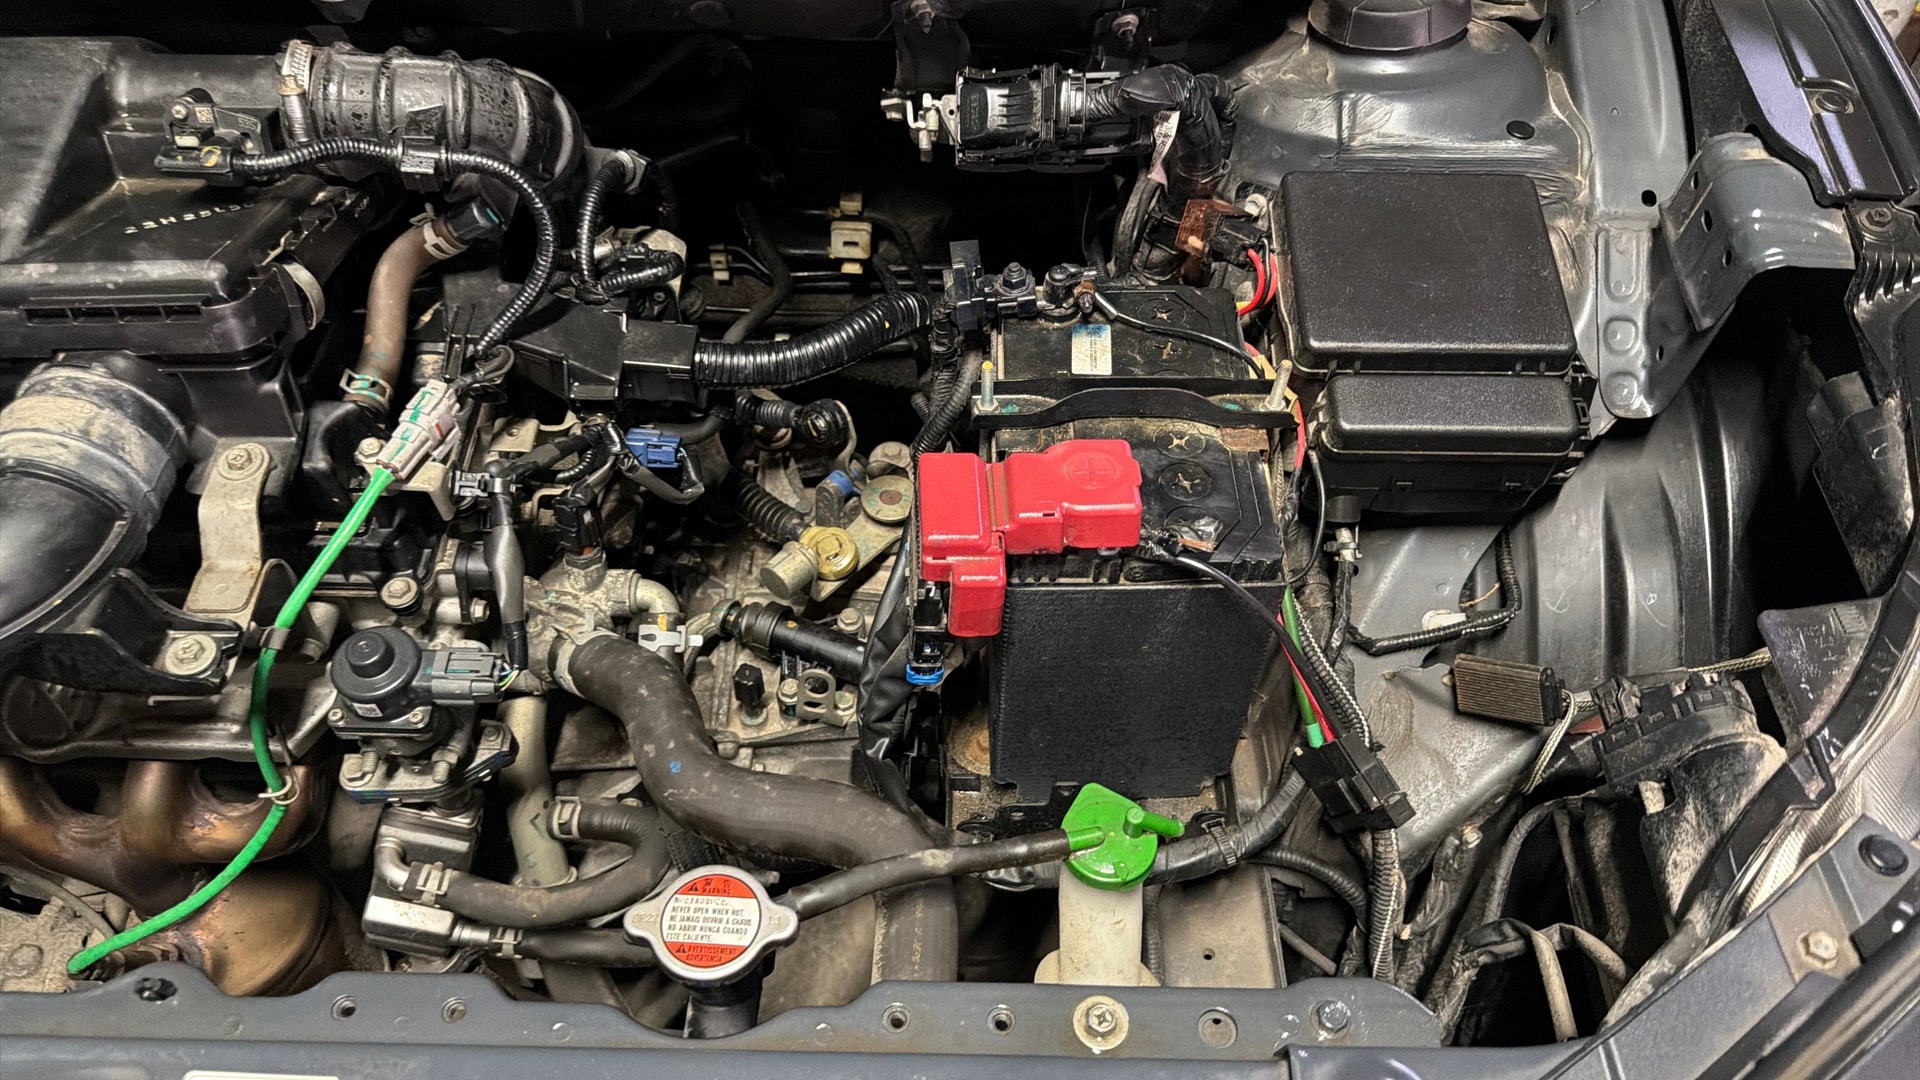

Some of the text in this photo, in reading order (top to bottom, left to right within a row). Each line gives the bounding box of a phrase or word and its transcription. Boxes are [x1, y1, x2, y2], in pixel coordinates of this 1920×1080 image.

[671, 905, 691, 914] NEVER
[693, 906, 709, 915] OPEN
[711, 907, 729, 916] WHEN
[669, 914, 678, 922] NE
[678, 915, 701, 923] JAMAIS
[702, 916, 724, 925] OUVRIR
[667, 923, 748, 936] NO ABRIR NUNCA CUANDO
[687, 945, 738, 956] AVERTISSEMENT
[685, 954, 723, 963] ADVERTENCIA
